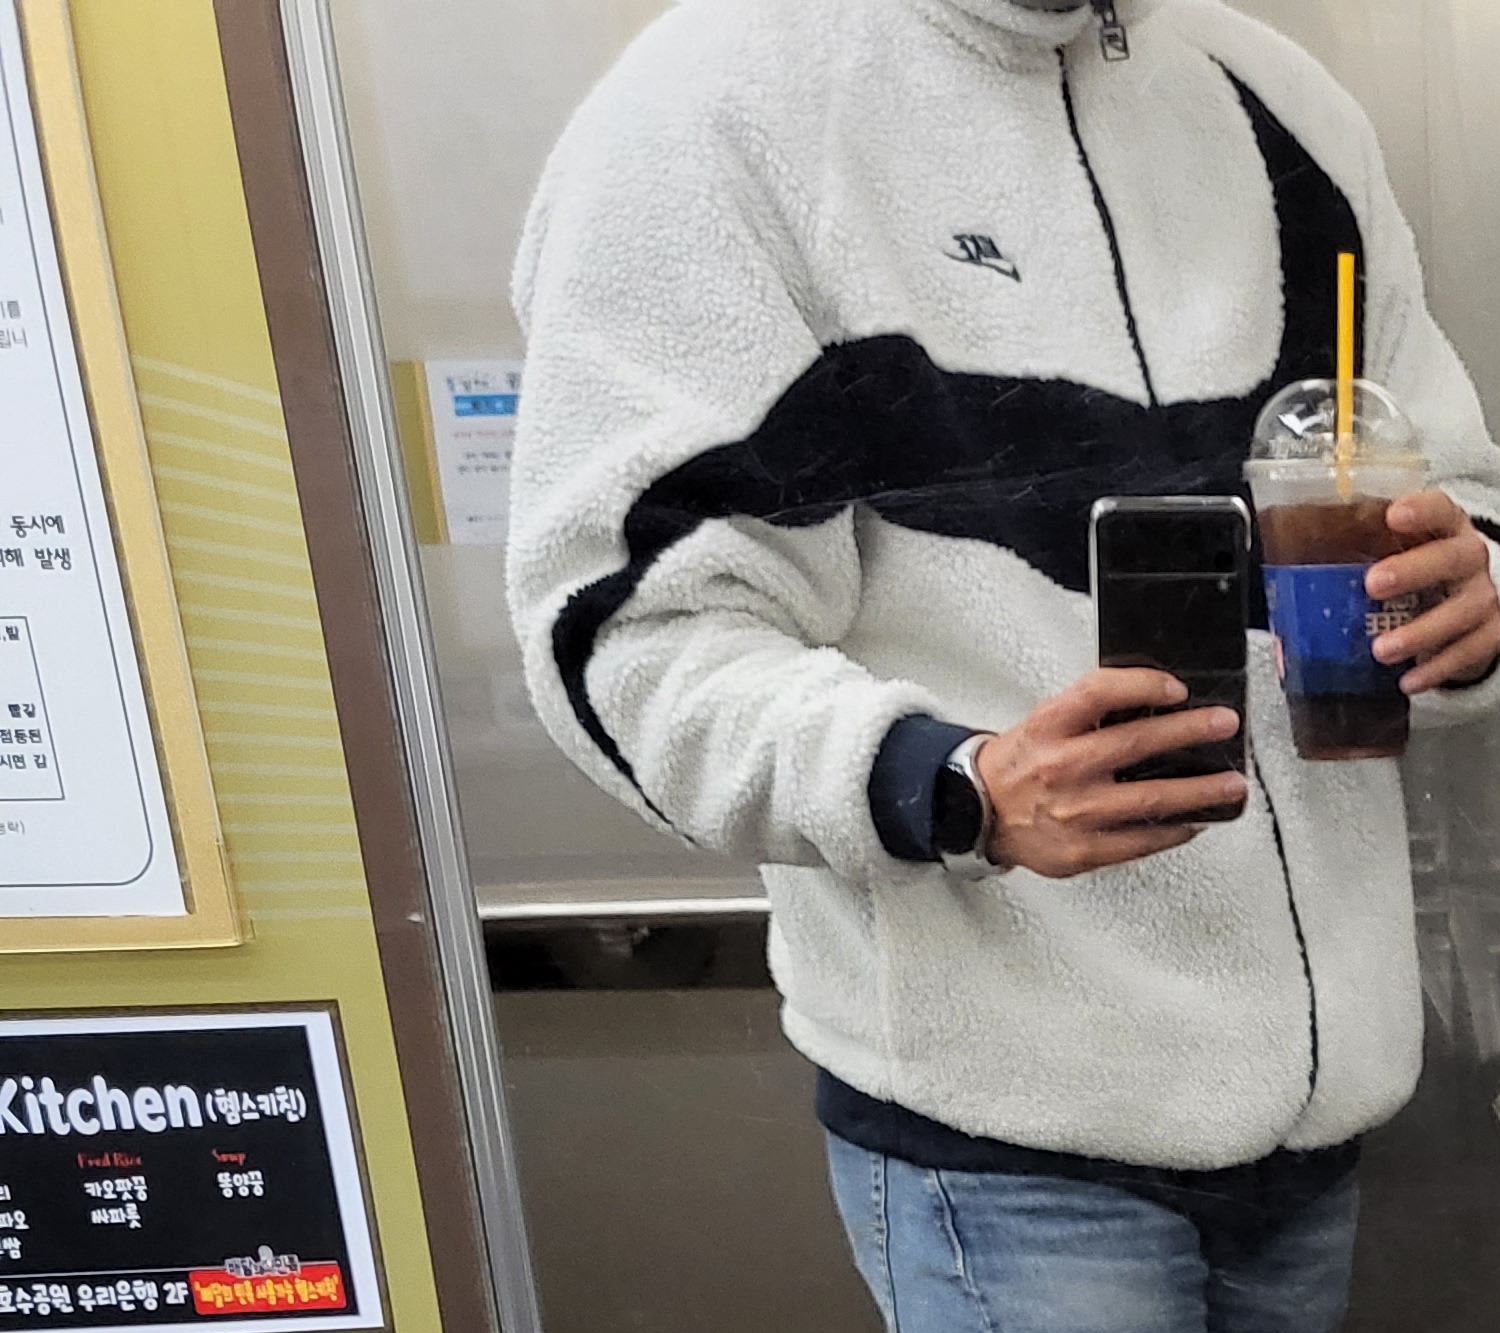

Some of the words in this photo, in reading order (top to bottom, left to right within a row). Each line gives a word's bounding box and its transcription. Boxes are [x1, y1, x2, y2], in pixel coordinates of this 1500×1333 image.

[10, 515, 65, 538] 동시에
[34, 547, 72, 570] 발생
[0, 1075, 203, 1135] Kitchen
[0, 1283, 74, 1315] 호수공원
[77, 1279, 159, 1312] 우리은행
[162, 1281, 189, 1304] 2F
